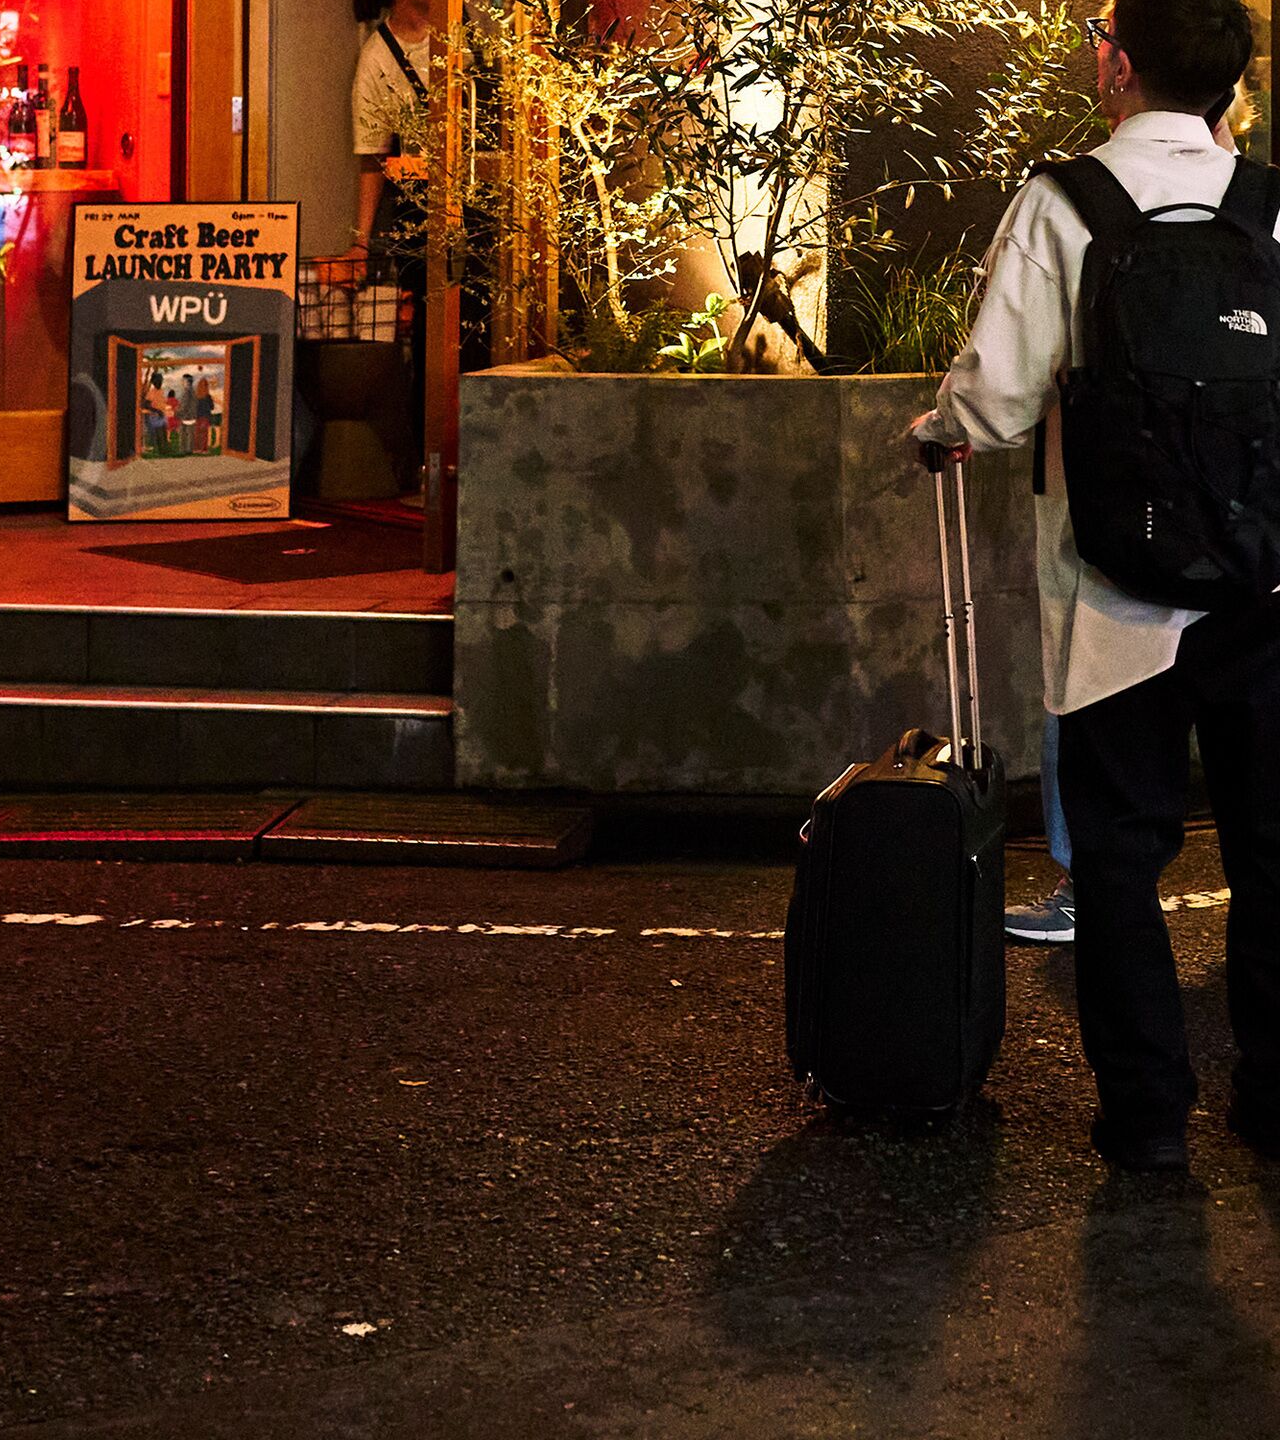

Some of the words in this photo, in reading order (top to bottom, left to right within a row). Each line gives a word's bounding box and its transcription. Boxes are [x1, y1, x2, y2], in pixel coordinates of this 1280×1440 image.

[84, 213, 99, 222] FRI
[102, 213, 114, 222] 29
[117, 212, 141, 221] MAR
[231, 211, 256, 222] 6pm
[267, 212, 289, 222] 11pm
[113, 223, 190, 250] Craft
[195, 222, 260, 248] Beer
[84, 252, 193, 281] LAUNCH
[200, 252, 288, 280] PARTY
[150, 291, 228, 326] WPÜ
[1232, 309, 1251, 318] THE
[1219, 315, 1251, 324] NORTH
[1228, 322, 1252, 333] FACE
